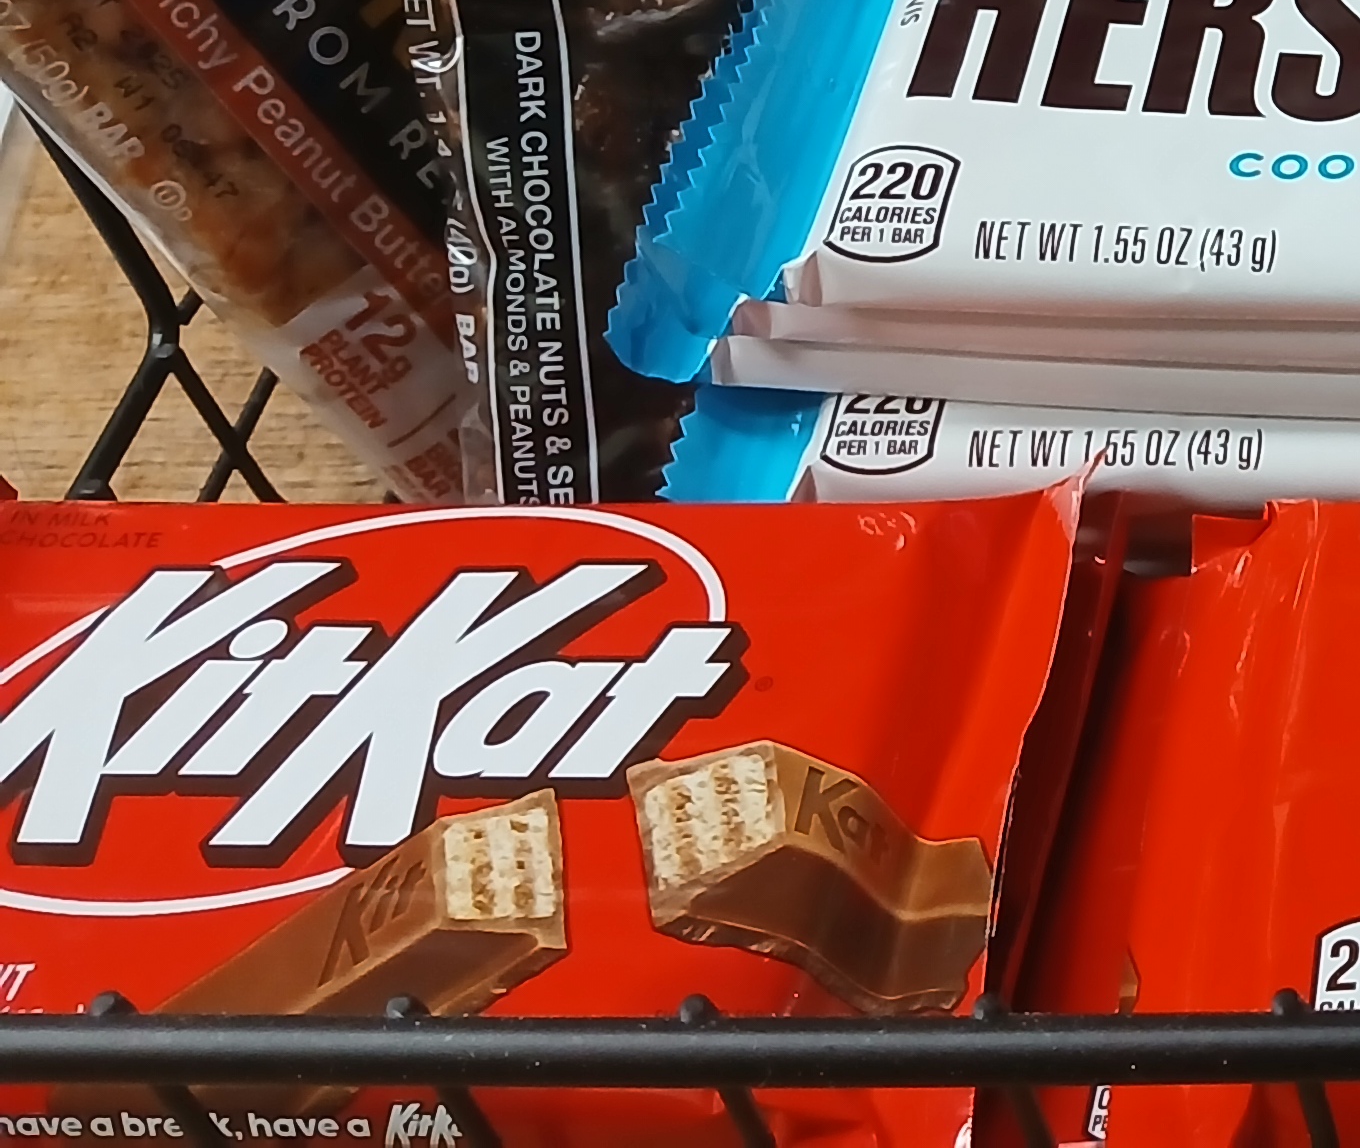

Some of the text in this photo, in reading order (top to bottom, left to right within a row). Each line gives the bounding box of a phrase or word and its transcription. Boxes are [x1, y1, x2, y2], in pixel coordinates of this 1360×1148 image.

[232, 66, 356, 202] Peanut
[849, 162, 941, 201] 220
[839, 205, 938, 226] CALORIES
[839, 226, 925, 246] PER 1 BAR
[514, 31, 573, 456] DARK CHOCOLATE NUTS &
[975, 221, 1278, 274] NET WT 1.55 OZ (43 g)
[343, 289, 416, 384] 12g
[486, 137, 540, 505] WITH ALMONDS & PEANUTS
[315, 328, 391, 394] PLANT
[300, 346, 387, 430] PROTEIN
[835, 419, 931, 439] CALORIES
[836, 439, 920, 457] PER BAR
[968, 429, 1264, 472] NET WT OZ (43 g)
[10, 509, 113, 527] IN MILK
[0, 559, 745, 860] KitKat
[317, 856, 428, 989] Kit
[89, 1112, 371, 1139] a have a
